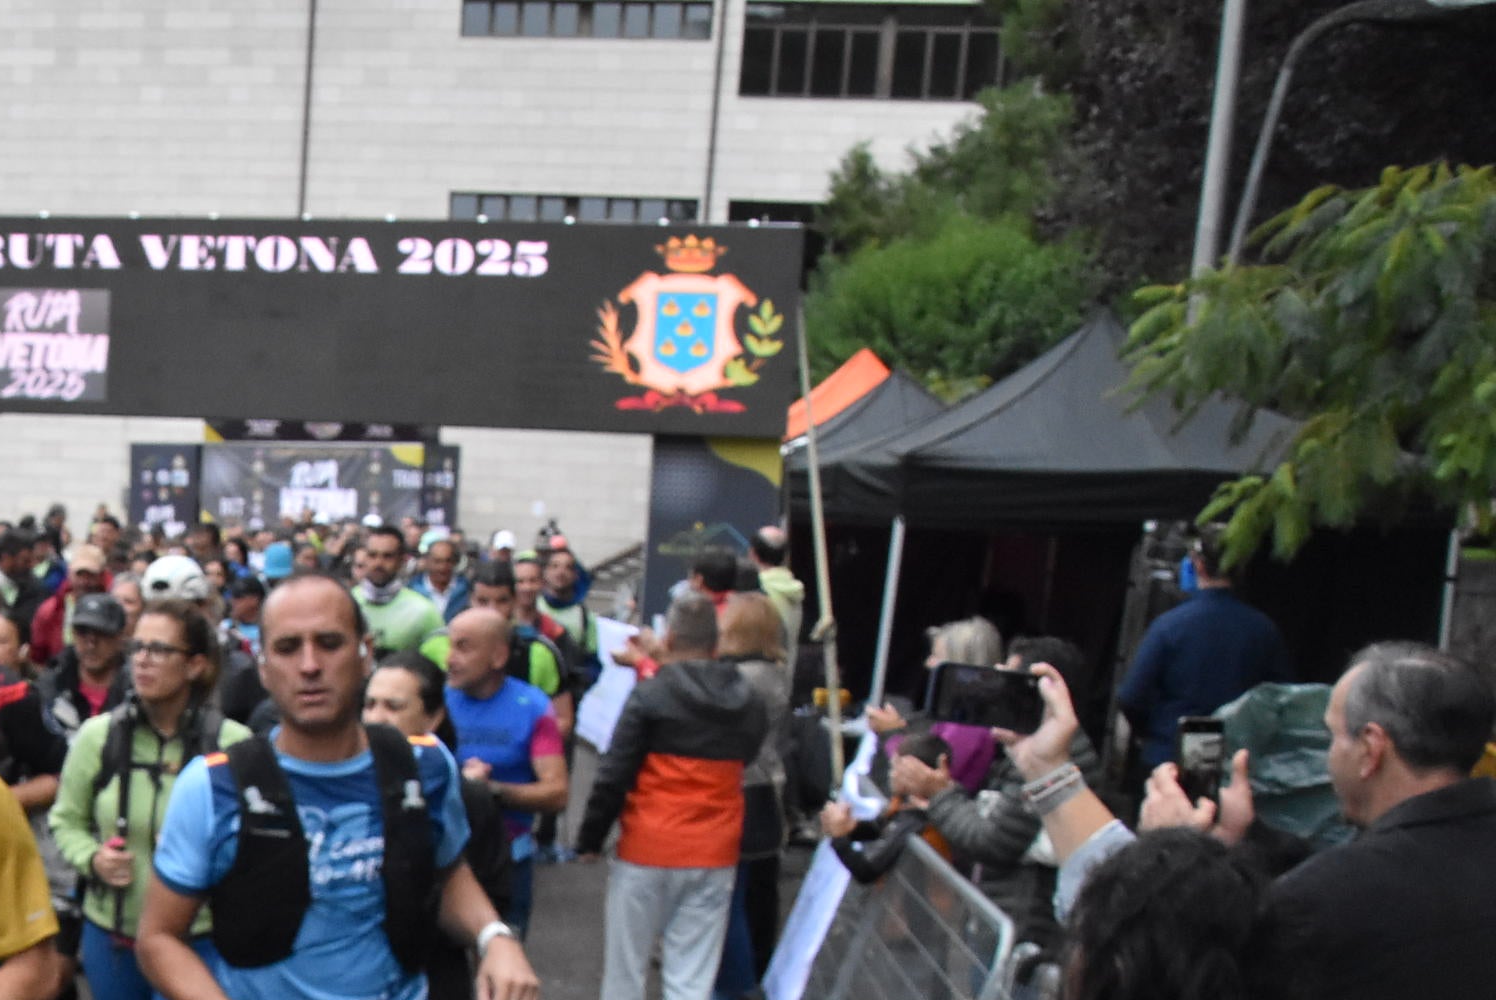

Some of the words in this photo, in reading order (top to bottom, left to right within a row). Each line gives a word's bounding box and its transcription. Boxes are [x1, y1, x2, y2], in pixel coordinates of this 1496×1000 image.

[140, 233, 379, 273] VETONA
[397, 237, 549, 277] 2025
[0, 367, 85, 401] 2025
